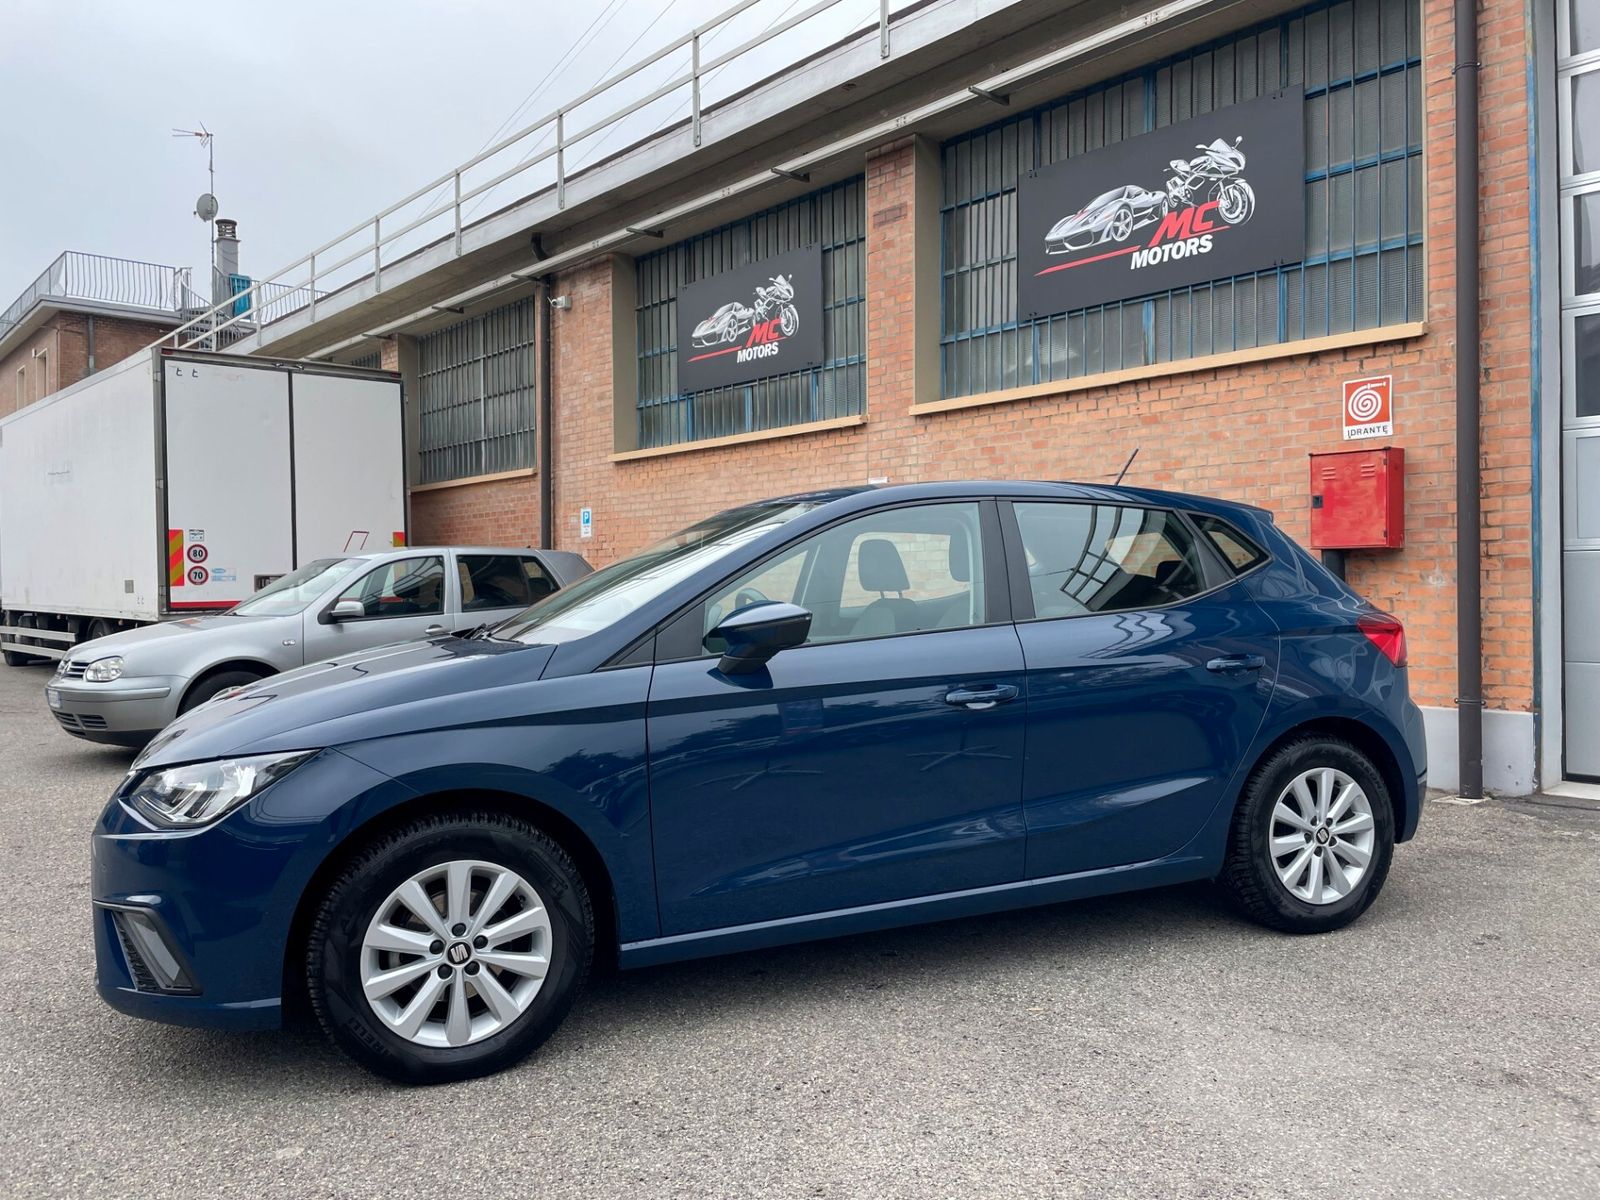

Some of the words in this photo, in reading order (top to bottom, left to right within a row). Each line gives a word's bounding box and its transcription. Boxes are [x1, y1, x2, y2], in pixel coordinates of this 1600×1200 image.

[1148, 200, 1220, 247] MC
[1130, 234, 1213, 270] MOTORS
[746, 318, 782, 347] MC
[737, 341, 779, 363] MOTORS
[1347, 425, 1388, 438] IDRANTE
[192, 549, 203, 558] 80
[193, 571, 203, 580] 70
